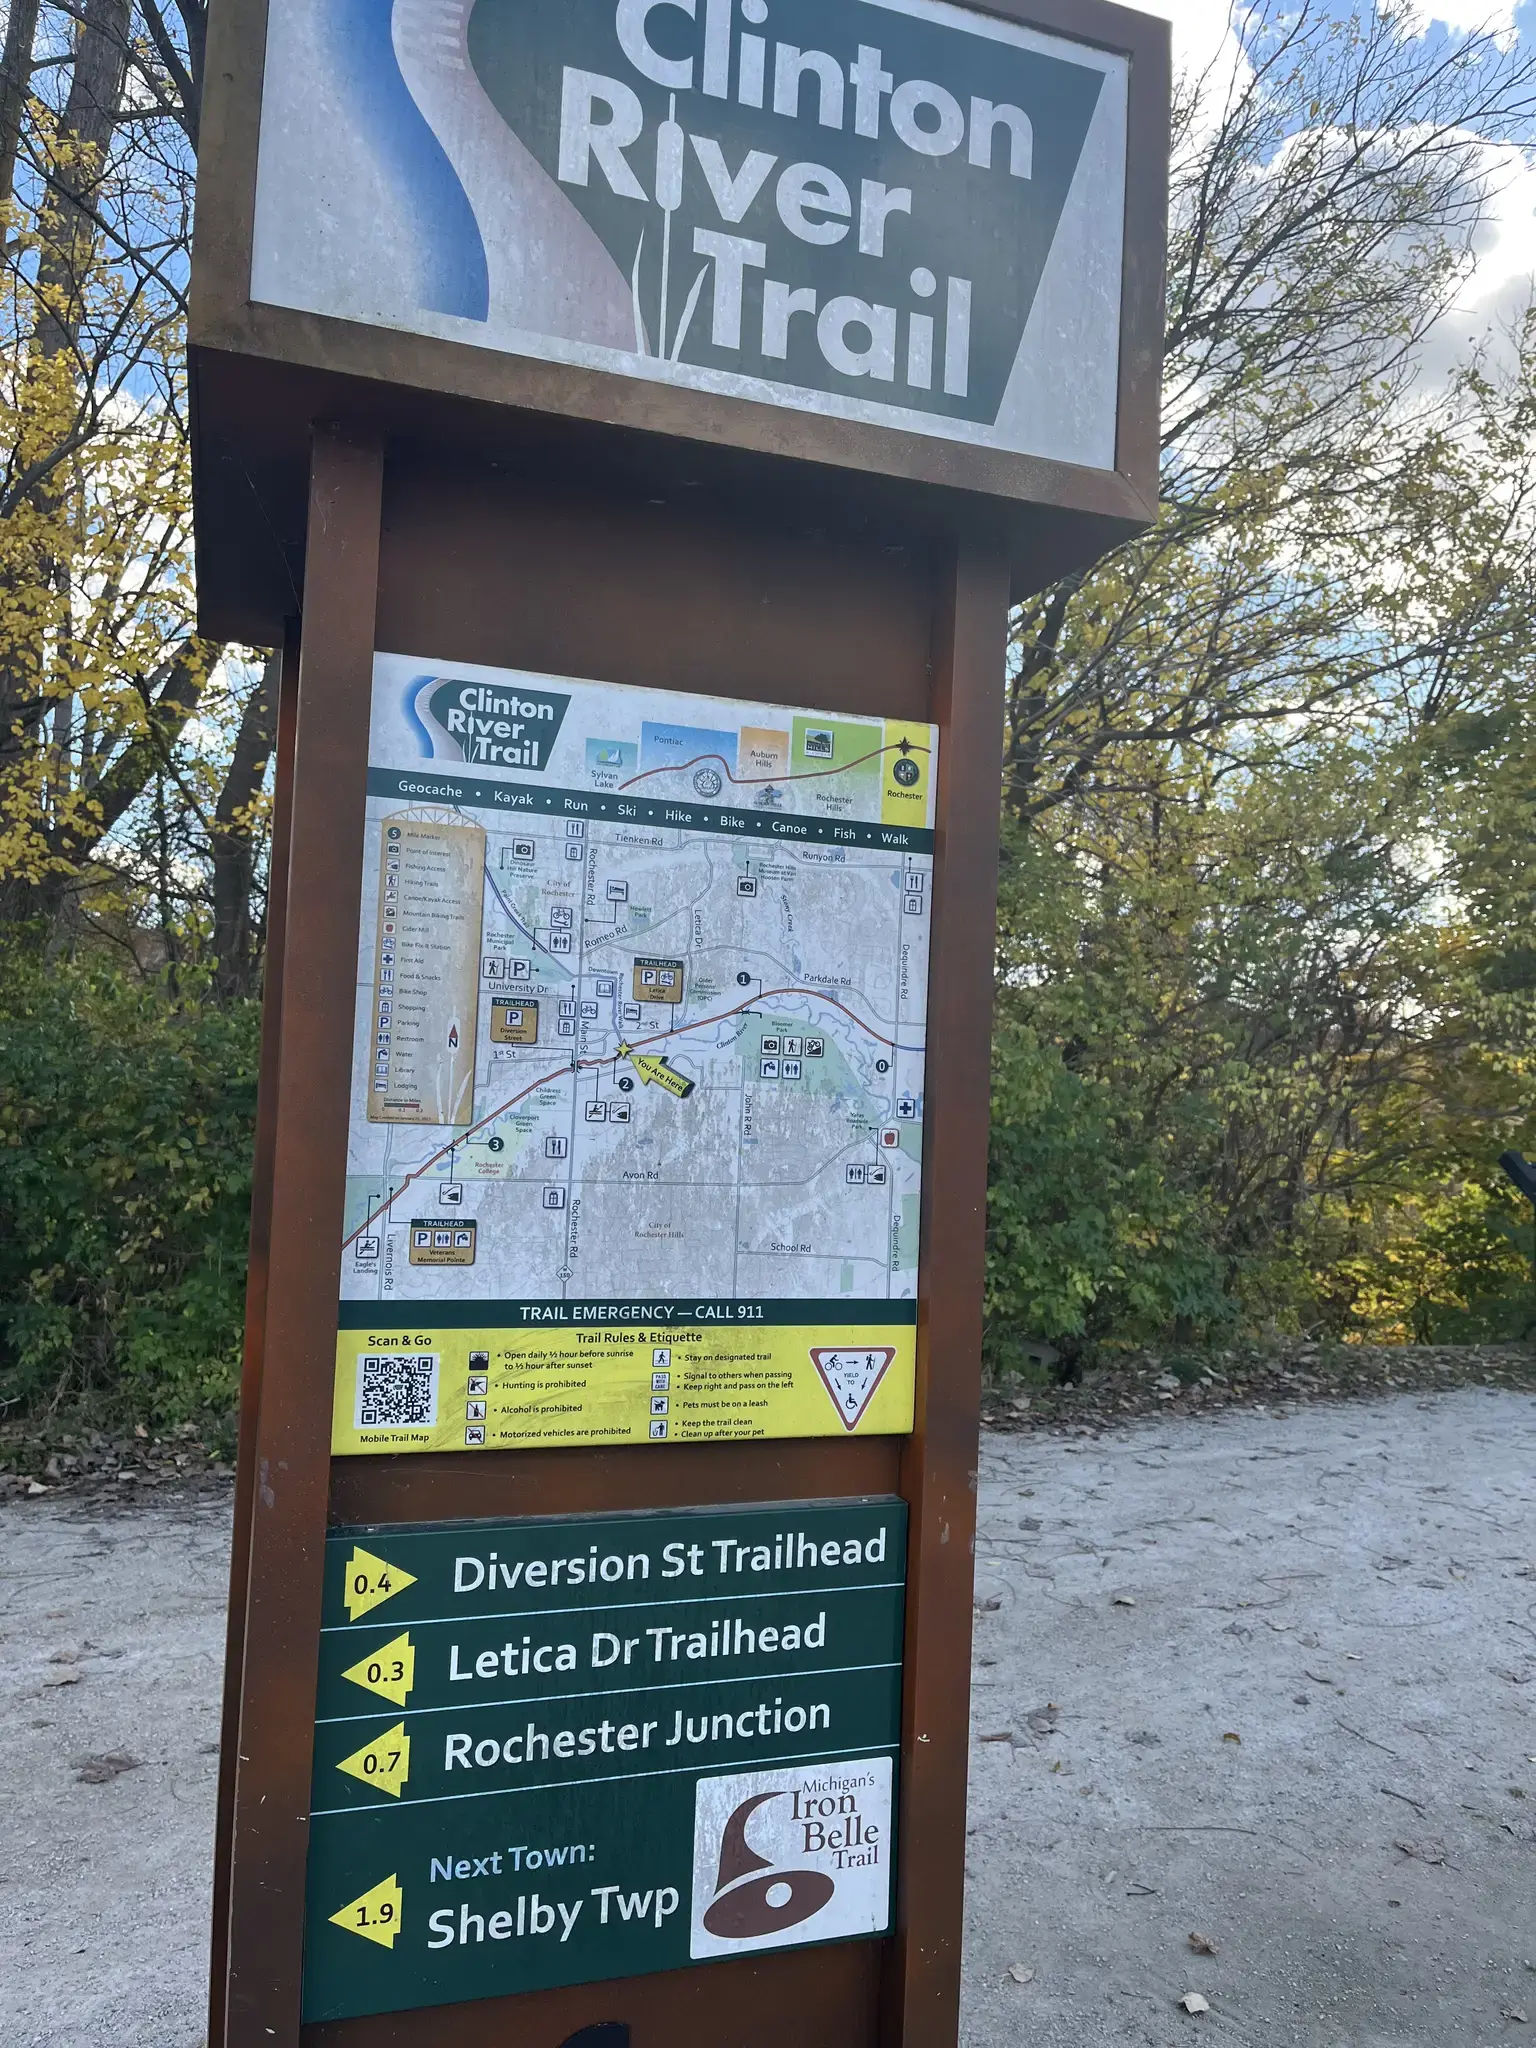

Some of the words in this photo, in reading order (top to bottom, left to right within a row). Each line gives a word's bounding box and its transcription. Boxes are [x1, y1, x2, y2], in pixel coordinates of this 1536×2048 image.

[614, 0, 1035, 180] Clinton
[557, 66, 913, 257] River
[693, 227, 972, 398] Trail
[459, 688, 554, 720] Clinton
[448, 708, 525, 739] River
[654, 736, 683, 746] Pontiac
[476, 737, 539, 766] Trail
[750, 750, 778, 760] Auburn
[756, 759, 772, 768] Hills
[591, 770, 618, 781] Sylvan
[594, 780, 614, 789] Lake
[816, 794, 852, 804] Rochester
[887, 790, 922, 800] Rochester
[398, 781, 462, 797] Geocache
[494, 791, 533, 805] Kayak
[564, 799, 588, 811] Run
[618, 805, 636, 817] Ski
[666, 810, 692, 823] Hike
[720, 816, 744, 828] Bike
[772, 821, 807, 835] Canoe
[834, 828, 856, 840] Fish
[882, 833, 908, 845] Walk
[826, 803, 842, 812] Hills
[616, 834, 650, 844] Tienken
[652, 838, 663, 846] Rd
[803, 852, 833, 862] Runyon
[835, 854, 846, 863] Rd
[588, 848, 597, 892] Rochester
[587, 895, 595, 905] Rd
[584, 933, 614, 948] Romeo
[615, 924, 627, 935] Rd
[695, 938, 702, 948] Dr
[901, 945, 910, 986] Dequindre
[804, 974, 838, 984] Parkdale
[841, 976, 851, 985] Rd
[488, 982, 535, 994] University
[537, 985, 548, 993] Dr
[901, 988, 908, 999] Rd
[398, 1004, 425, 1012] Shopping
[581, 1021, 589, 1042] Main
[580, 1045, 588, 1054] St
[638, 1057, 651, 1071] You
[651, 1068, 665, 1080] Are
[665, 1077, 683, 1092] Here
[745, 1094, 753, 1114] John
[744, 1123, 751, 1135] Rd
[622, 1171, 645, 1179] Avon
[647, 1171, 659, 1180] Rd
[571, 1200, 580, 1244] Rochester
[570, 1246, 578, 1258] Rd
[771, 1243, 798, 1252] School
[385, 1234, 396, 1276] Livernois
[384, 1278, 393, 1290] Rd
[520, 1306, 568, 1320] TRAIL
[572, 1306, 674, 1320] EMERGENCY
[695, 1306, 734, 1319] CALL
[737, 1306, 764, 1319] 911
[368, 1336, 398, 1346] Scan
[402, 1336, 411, 1346] &
[414, 1336, 432, 1346] Go
[576, 1333, 604, 1343] Trail
[607, 1333, 636, 1343] Rules
[638, 1333, 646, 1342] &
[650, 1332, 702, 1344] Etiquette
[504, 1351, 525, 1360] Open
[527, 1350, 548, 1360] daily
[559, 1350, 577, 1358] hour
[580, 1350, 604, 1358] before
[606, 1350, 634, 1358] sunrise
[685, 1353, 701, 1363] Stay
[714, 1353, 755, 1362] designated
[515, 1362, 523, 1370] ½
[567, 1361, 592, 1369] sunset
[683, 1372, 708, 1382] Signal
[720, 1372, 742, 1380] others
[744, 1371, 764, 1379] when
[765, 1371, 792, 1381] passing
[502, 1381, 534, 1391] Hunting
[546, 1380, 586, 1389] prohibited
[683, 1383, 700, 1391] Keep
[703, 1382, 721, 1391] right
[737, 1382, 752, 1391] pass
[501, 1405, 531, 1414] Alcohol
[542, 1404, 582, 1414] prohibited
[682, 1419, 700, 1428] Keep
[703, 1419, 715, 1427] the
[733, 1418, 752, 1426] clean
[500, 1430, 541, 1438] Motorized
[543, 1429, 574, 1437] vehicles
[590, 1427, 631, 1436] prohibited
[681, 1429, 701, 1437] Clean
[703, 1430, 712, 1438] up
[714, 1429, 732, 1437] after
[735, 1429, 749, 1437] your
[360, 1434, 389, 1442] Mobile
[391, 1434, 408, 1442] Trail
[410, 1434, 430, 1444] Map
[454, 1546, 650, 1593] Diversion
[661, 1544, 705, 1577] St
[711, 1527, 887, 1573] Trailhead
[354, 1573, 392, 1594] 0.4
[449, 1637, 577, 1681] Letica
[591, 1632, 640, 1668] Dr
[645, 1612, 827, 1662] Trailhead
[366, 1662, 405, 1683] 0.3
[444, 1721, 658, 1771] Rochester
[666, 1701, 831, 1746] Junction
[362, 1751, 401, 1773] 0.7
[802, 1772, 875, 1795] Michigan's
[790, 1790, 857, 1821] Iron
[801, 1813, 880, 1854] Belle
[429, 1850, 503, 1884] Next
[508, 1841, 596, 1874] Town:
[832, 1845, 879, 1870] Trail
[355, 1904, 394, 1927] 1.9
[427, 1897, 584, 1949] Shelby
[590, 1885, 680, 1928] Twp
